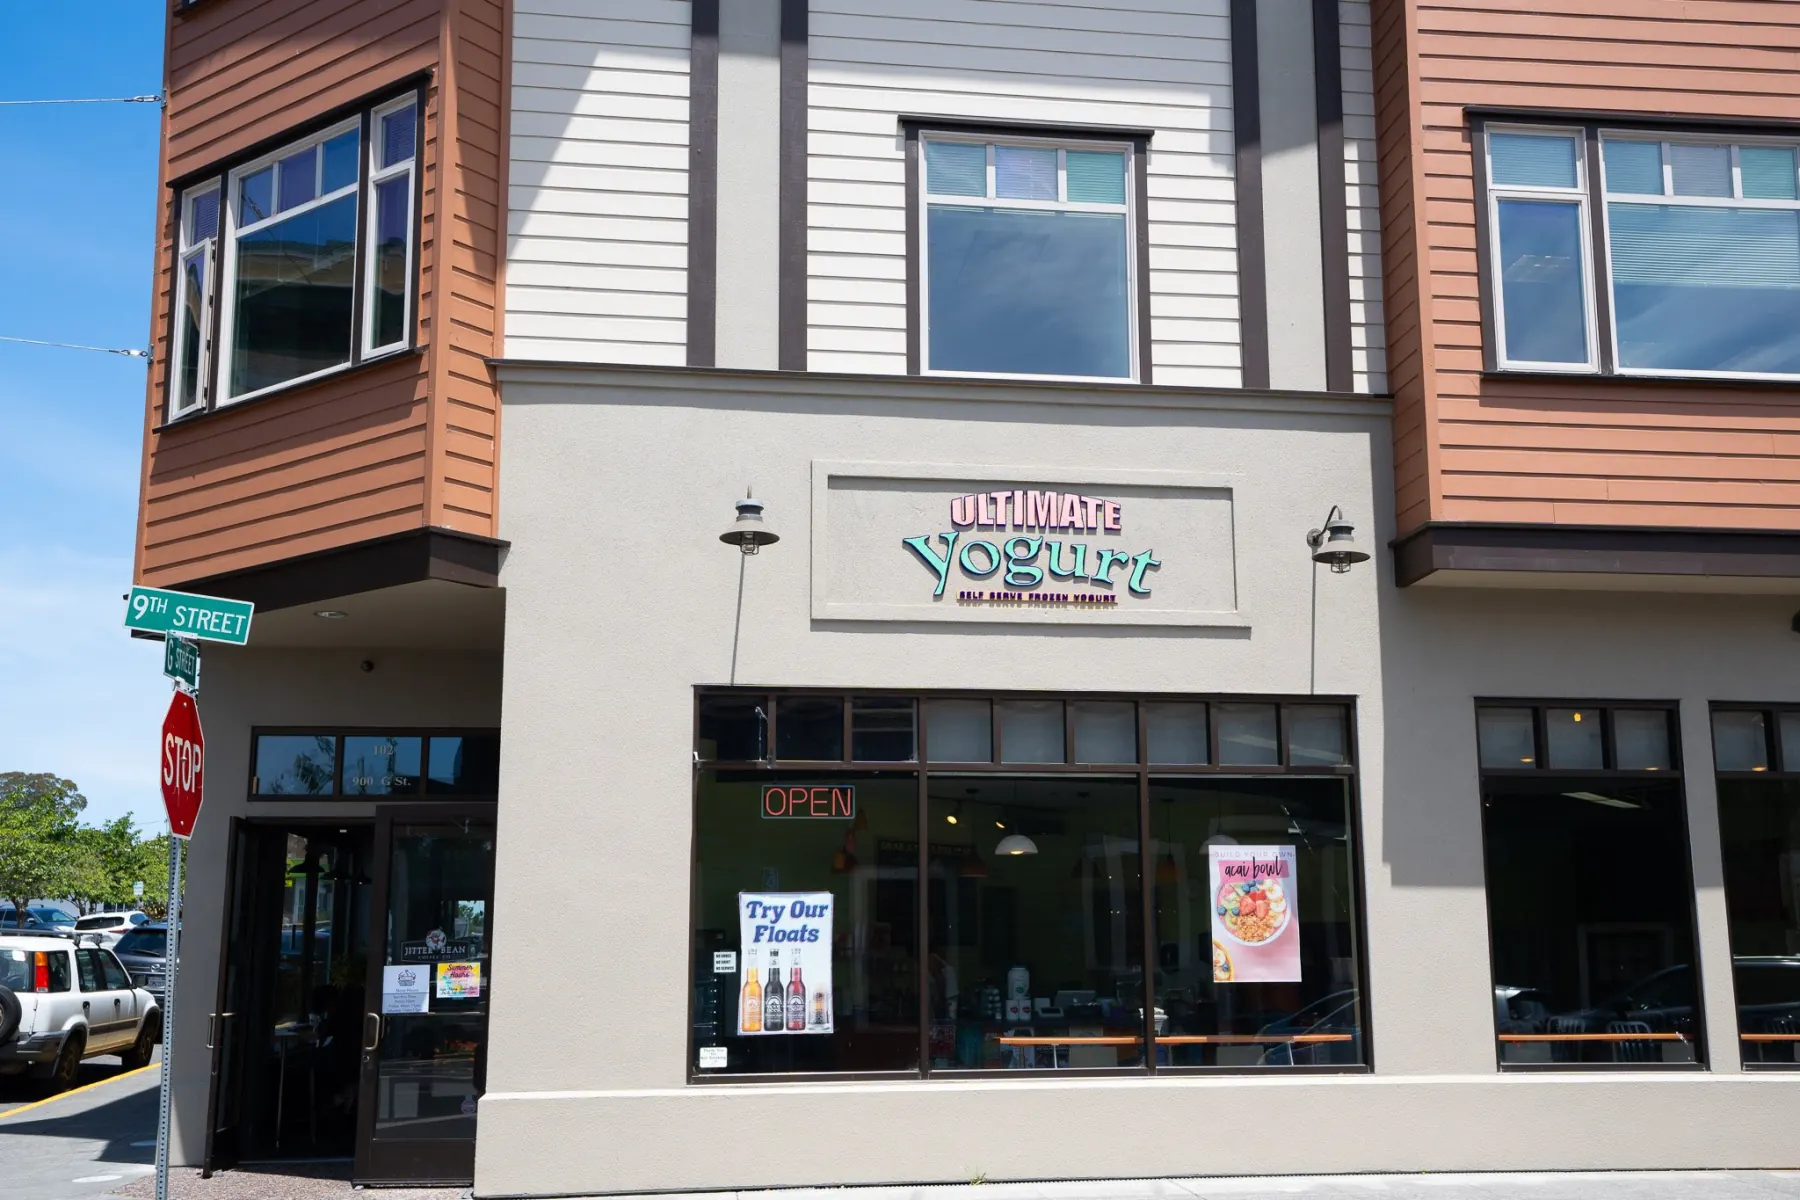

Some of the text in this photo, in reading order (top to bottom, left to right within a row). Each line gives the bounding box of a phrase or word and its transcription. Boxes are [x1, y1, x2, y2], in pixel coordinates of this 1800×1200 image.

[950, 490, 1122, 530] ULTIMATE
[959, 591, 1117, 603] SELF SERVE FROZEN YOGURT
[133, 595, 247, 635] 9TH STREET
[175, 648, 195, 675] STREET
[373, 744, 394, 756] 102
[164, 732, 202, 793] STOP
[352, 776, 411, 786] 900 G St.
[765, 787, 851, 816] OPEN
[1225, 856, 1283, 879] acai bowl
[746, 900, 829, 924] Try Our
[753, 924, 820, 943] Floats
[440, 945, 466, 954] BEAN
